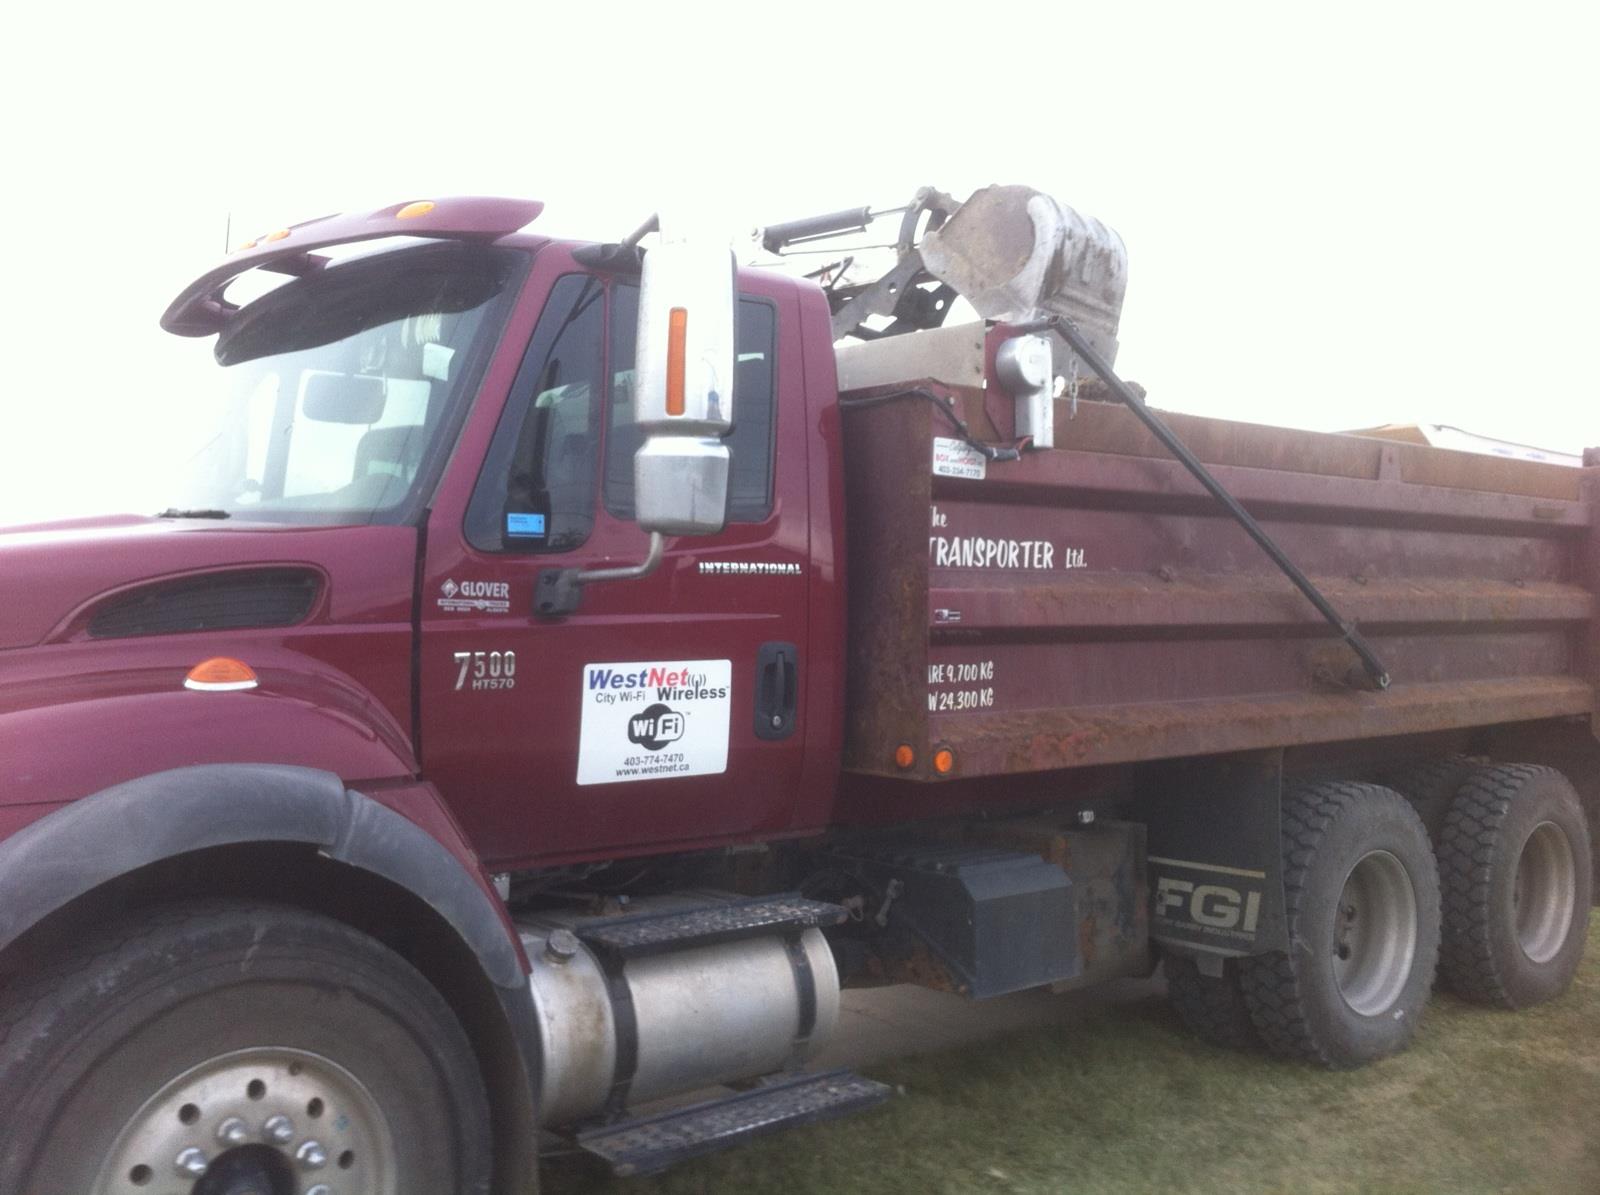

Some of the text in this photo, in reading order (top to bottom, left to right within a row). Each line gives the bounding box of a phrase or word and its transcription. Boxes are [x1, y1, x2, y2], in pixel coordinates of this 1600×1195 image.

[930, 505, 948, 527] he
[1066, 547, 1088, 569] Ltd.
[699, 562, 802, 575] INTERNATIONAL
[460, 580, 510, 599] GLOVER
[453, 650, 516, 691] 7500
[589, 666, 689, 690] WestNet
[946, 663, 978, 684] 9,700
[980, 660, 994, 681] KG
[472, 678, 516, 691] HT570
[657, 684, 726, 701] Wireless
[595, 691, 646, 705] City Wi-Fi
[939, 690, 978, 711] 24,300
[980, 687, 994, 707] KG
[616, 763, 690, 776] www.westnet.ca
[624, 753, 684, 766] 403-774-7470
[1155, 877, 1262, 932] FGI
